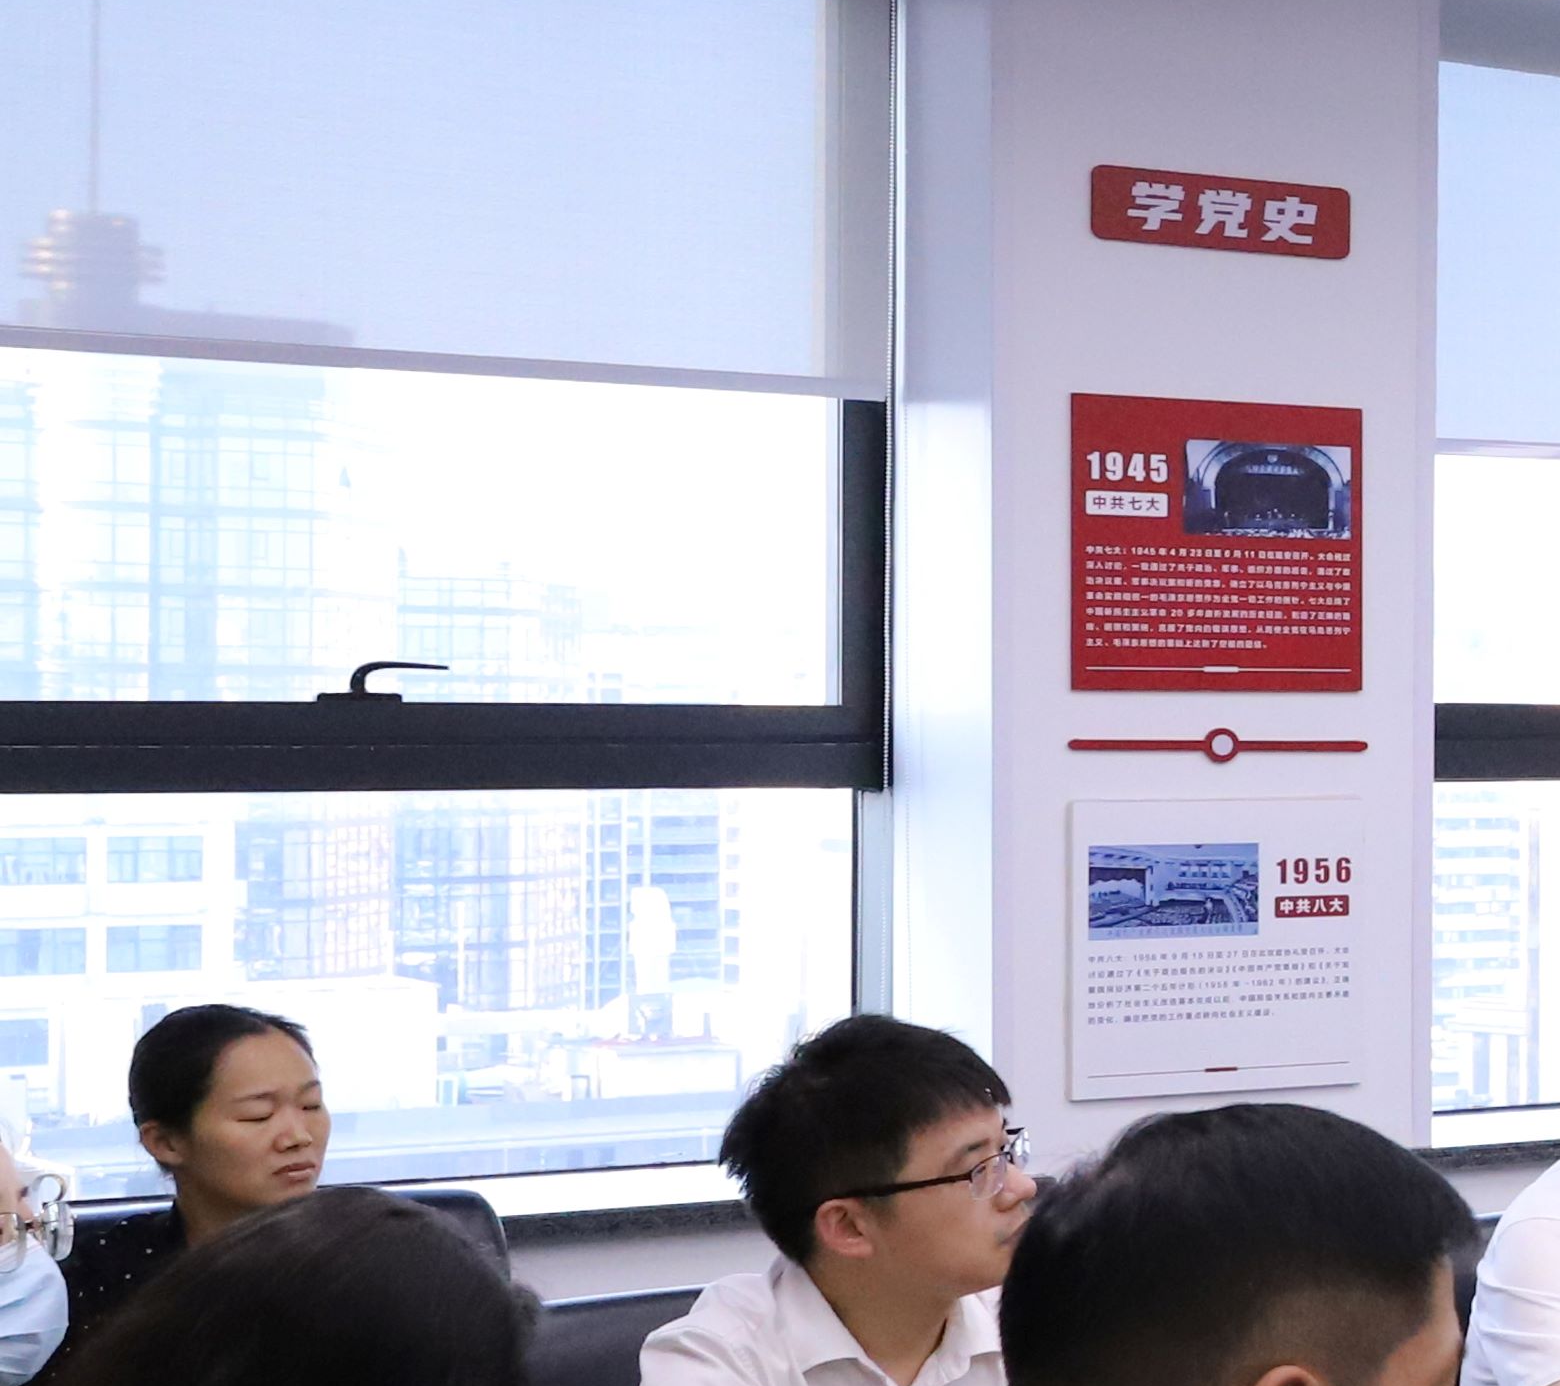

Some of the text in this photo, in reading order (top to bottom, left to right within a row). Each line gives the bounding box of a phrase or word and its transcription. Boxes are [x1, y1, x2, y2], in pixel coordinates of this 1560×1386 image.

[1126, 180, 1318, 245] 学党史
[1086, 451, 1168, 484] 1945
[1092, 495, 1161, 513] 中共七大
[1276, 857, 1352, 884] 1956
[1279, 897, 1344, 914] 中共八大
